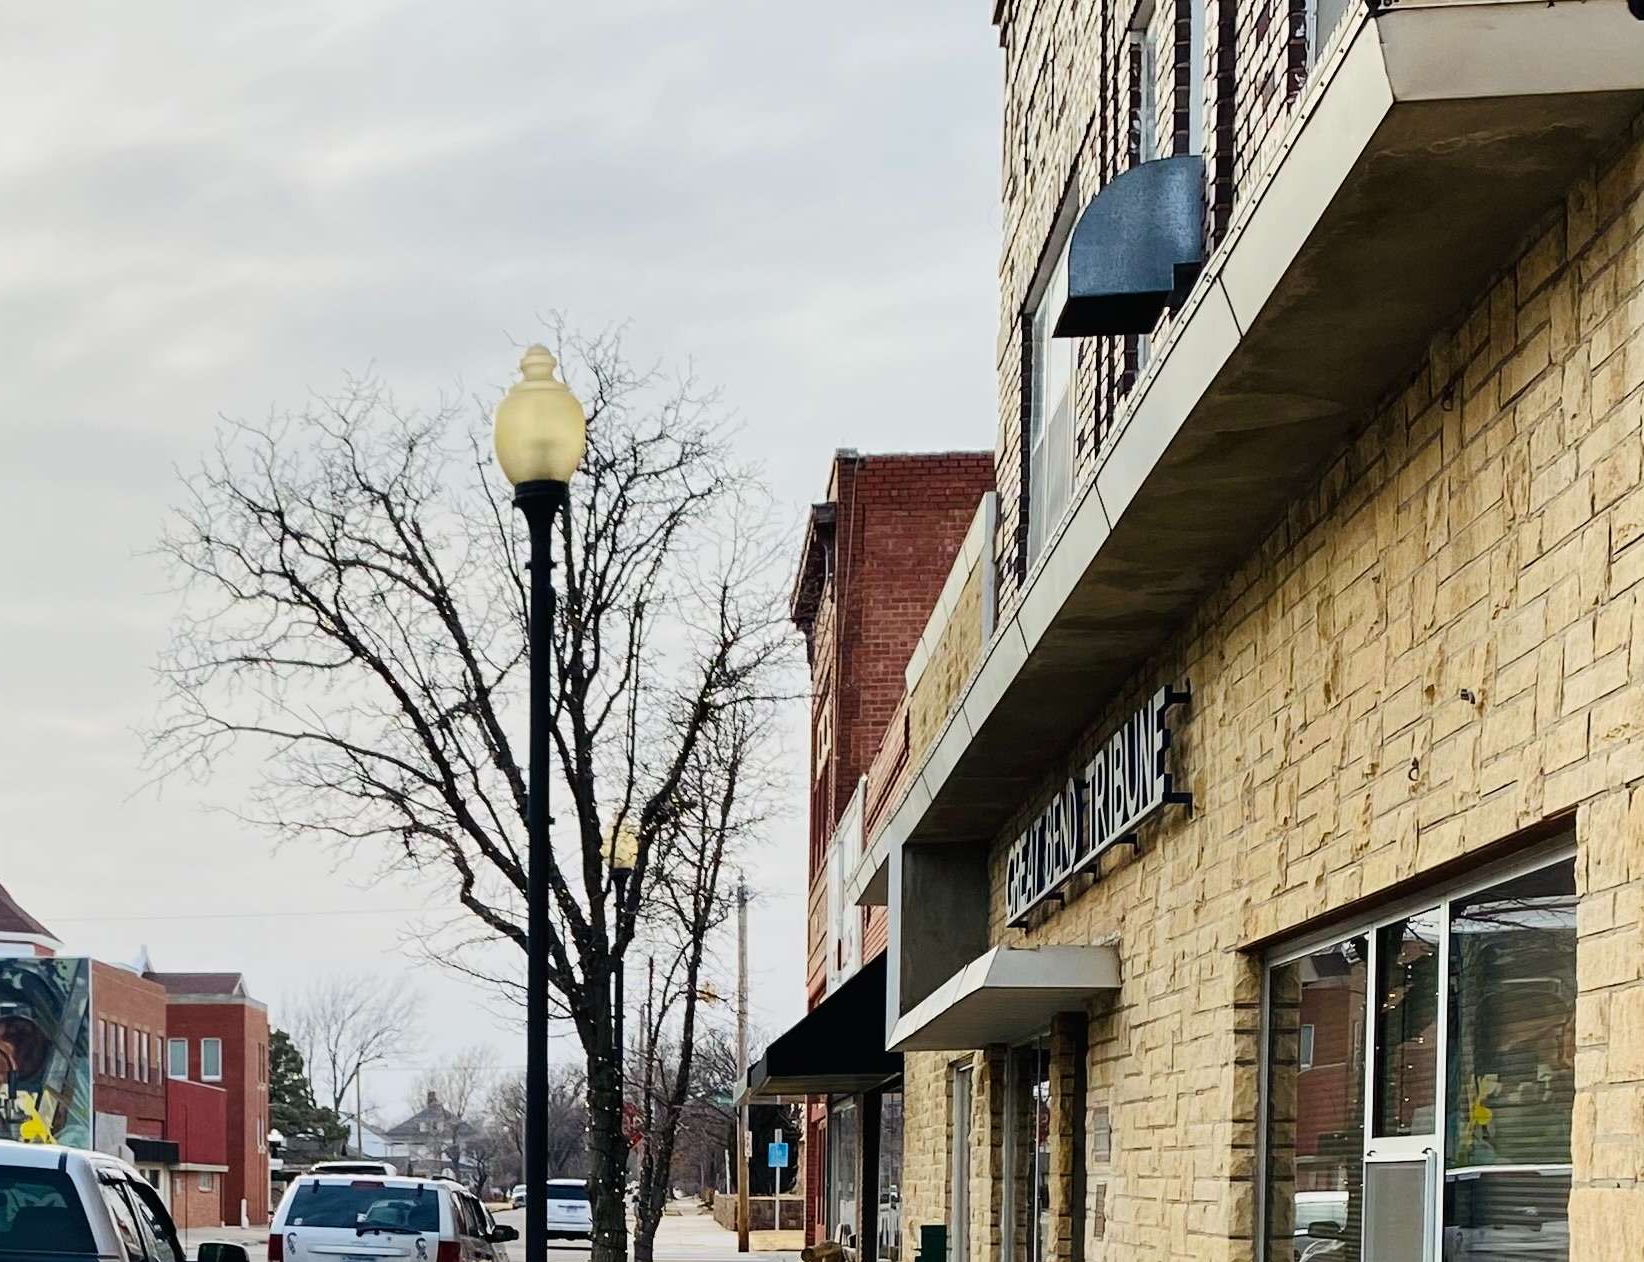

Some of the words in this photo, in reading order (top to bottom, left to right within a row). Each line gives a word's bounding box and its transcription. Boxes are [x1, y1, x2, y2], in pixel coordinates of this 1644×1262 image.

[1006, 817, 1043, 918] GREAT
[1044, 776, 1078, 891] BEND
[1085, 685, 1166, 852] TRIBUNE
